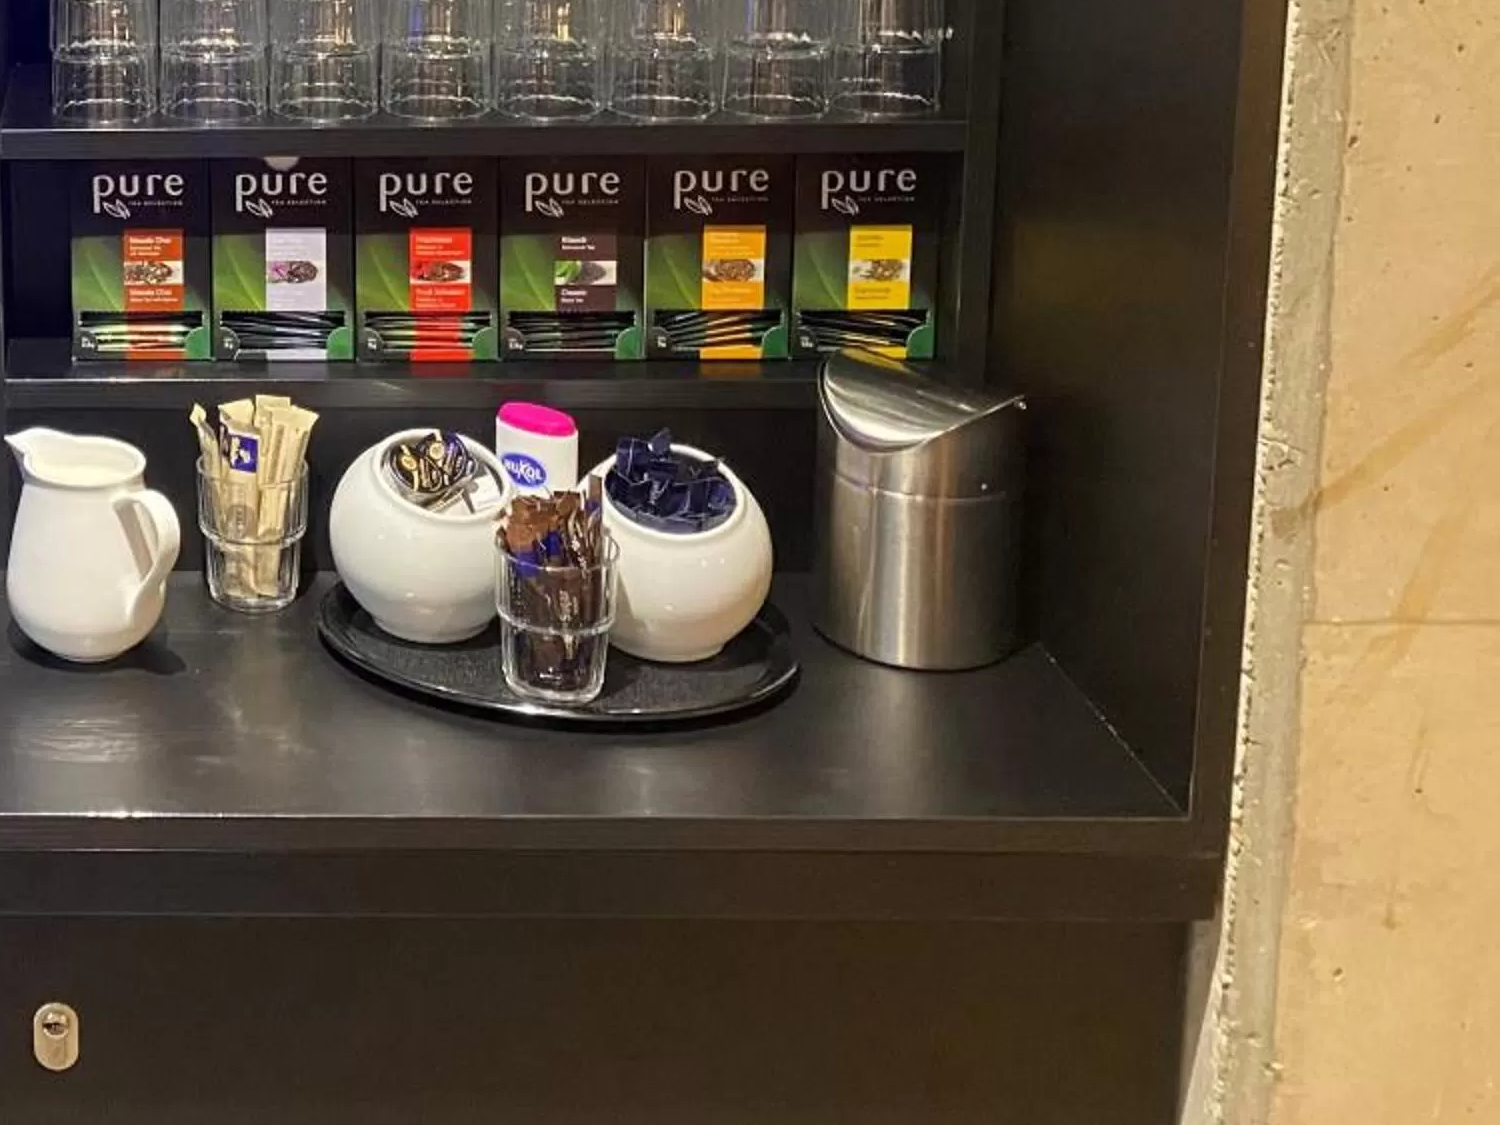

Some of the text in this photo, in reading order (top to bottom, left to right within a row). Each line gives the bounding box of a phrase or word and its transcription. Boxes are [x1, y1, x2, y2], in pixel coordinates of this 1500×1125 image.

[93, 174, 184, 214] pure
[236, 173, 327, 212] pure
[380, 172, 473, 212] pure
[525, 172, 620, 212] pure
[674, 170, 769, 210] pure
[821, 169, 916, 210] pure
